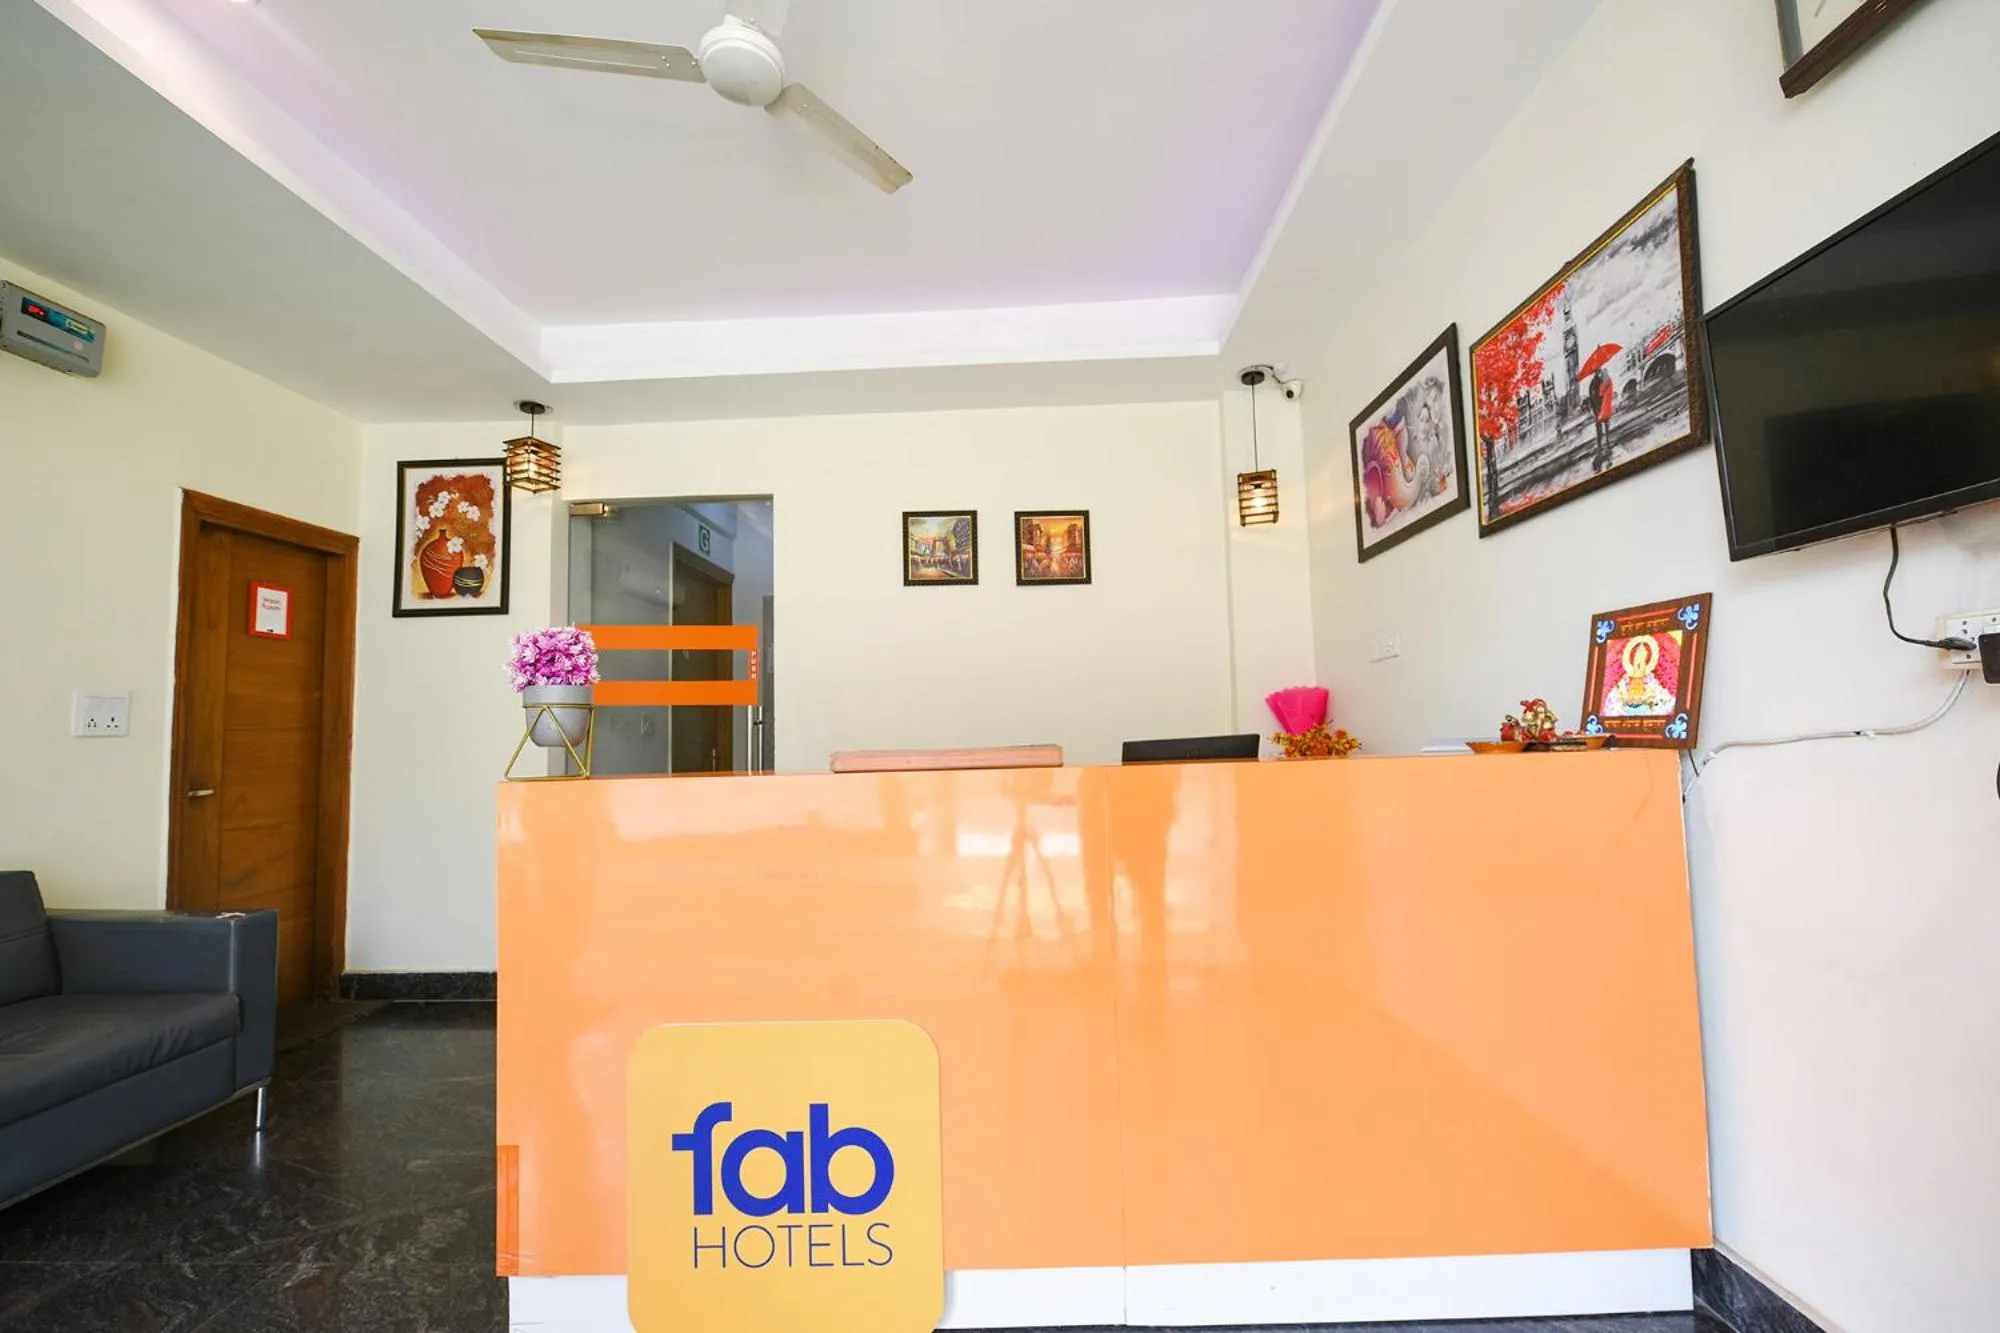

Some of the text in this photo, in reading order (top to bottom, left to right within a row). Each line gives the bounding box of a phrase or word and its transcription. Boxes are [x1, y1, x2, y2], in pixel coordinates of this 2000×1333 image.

[700, 528, 709, 552] G
[672, 1101, 894, 1216] fab
[693, 1222, 893, 1269] HOTELS
